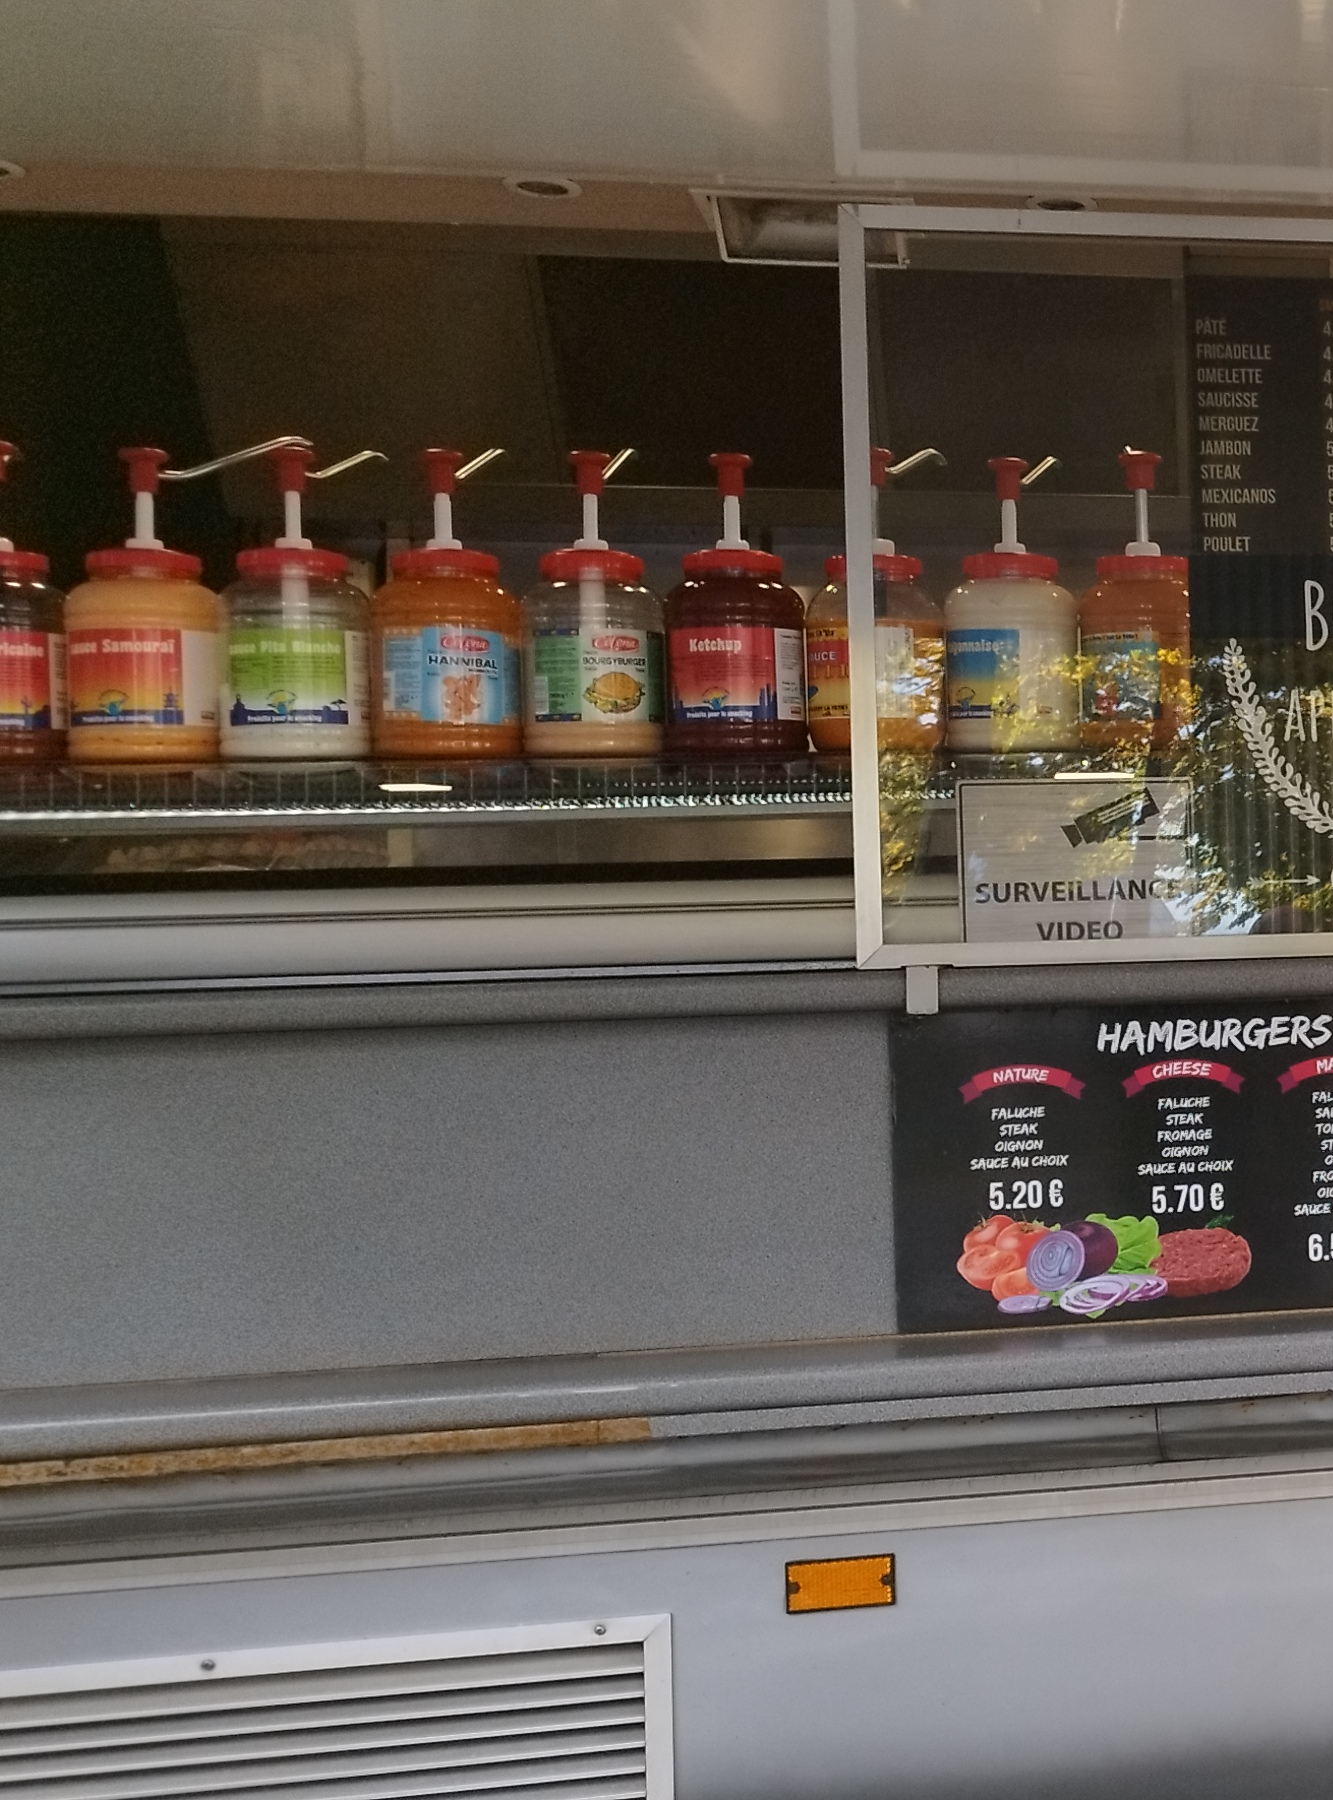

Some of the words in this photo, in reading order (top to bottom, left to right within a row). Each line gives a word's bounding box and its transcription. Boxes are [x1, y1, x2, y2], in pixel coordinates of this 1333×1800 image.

[1195, 317, 1226, 335] PÂTÉ
[1196, 344, 1271, 360] FRICADELLE
[1198, 369, 1263, 384] OMELETTE
[1198, 392, 1258, 407] SAUCISSE
[1199, 417, 1259, 431] MERGUEZ
[1200, 441, 1251, 456] JAMBON
[1201, 465, 1241, 479] STEAK
[1202, 489, 1276, 503] MEXICANOS
[1203, 513, 1236, 527] THON
[1204, 537, 1250, 551] POULET
[102, 638, 175, 654] Samouraï
[689, 638, 742, 654] Ketchup
[428, 655, 498, 670] HANNIBAL
[1037, 921, 1123, 941] VIDEO
[1097, 1014, 1332, 1054] HAMBURGERS
[992, 1066, 1049, 1084] NATURE
[1152, 1061, 1211, 1079] CHEESE
[1158, 1096, 1209, 1109] FALUCHE
[991, 1106, 1045, 1120] FALUCHE
[1166, 1112, 1203, 1126] STEAK
[999, 1122, 1038, 1136] STEAK
[1156, 1128, 1212, 1141] FROMAGE
[994, 1139, 1043, 1152] OIGNON
[1162, 1144, 1208, 1157] OIGNON
[970, 1157, 1012, 1170] SAUCE
[1014, 1156, 1029, 1168] AU
[1032, 1154, 1068, 1168] CHOIX
[1138, 1161, 1179, 1174] SAUCE
[1182, 1161, 1196, 1173] AU
[1199, 1160, 1233, 1173] CHOIX
[989, 1180, 1044, 1210] 5.20
[1049, 1179, 1063, 1207] €
[1152, 1184, 1205, 1214] 5.70
[1209, 1184, 1224, 1211] €
[1294, 1202, 1333, 1216] SAUCE
